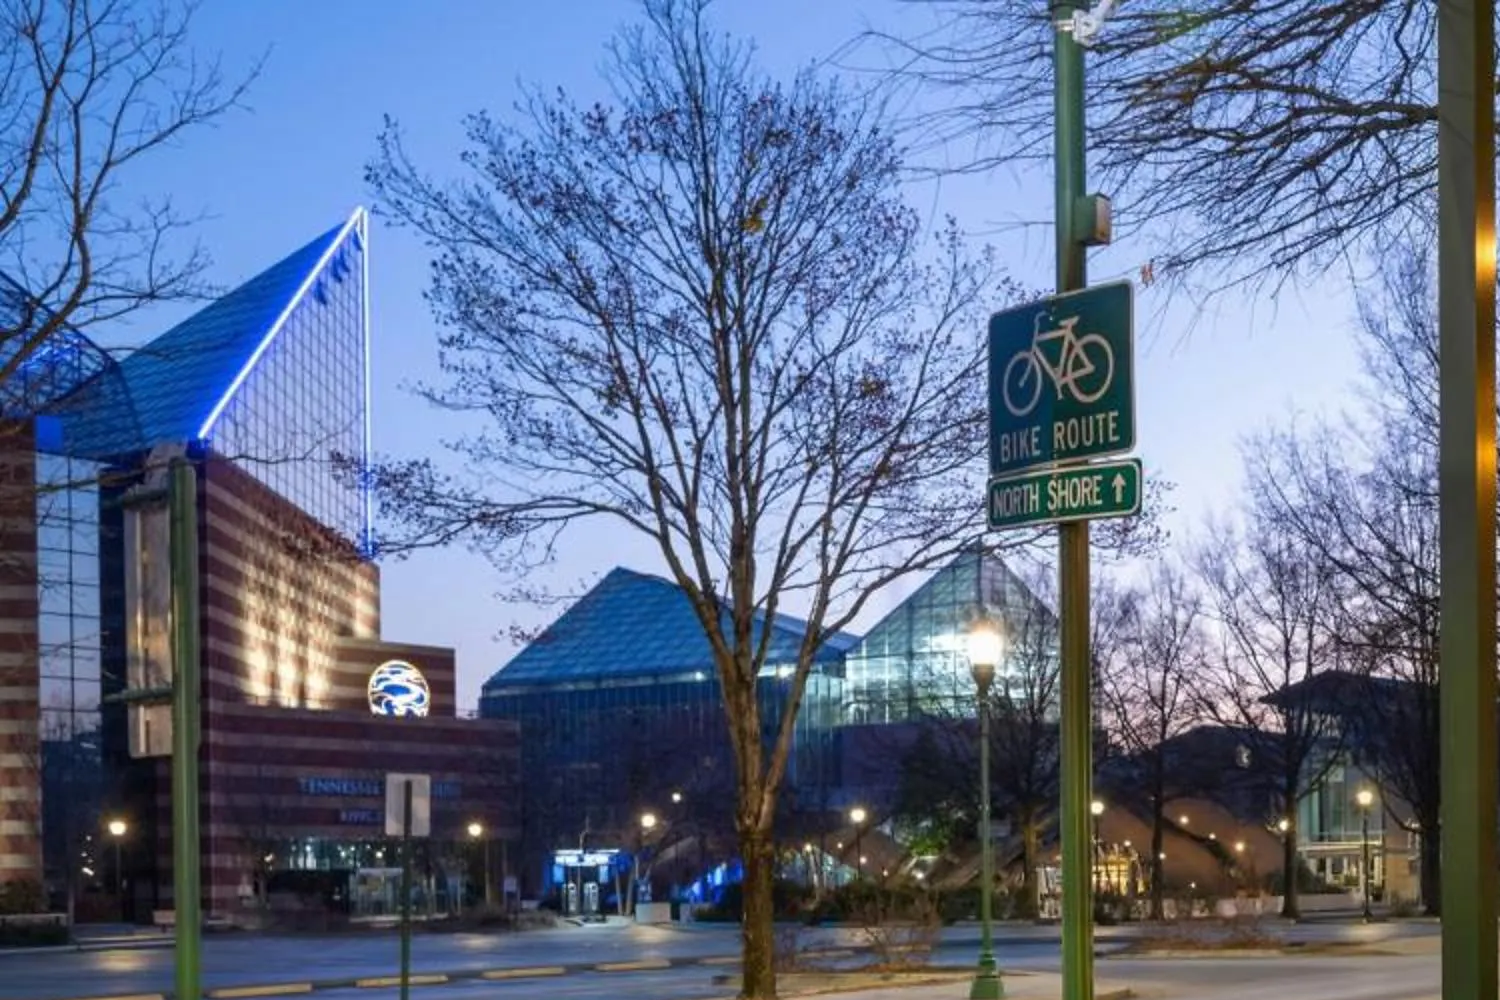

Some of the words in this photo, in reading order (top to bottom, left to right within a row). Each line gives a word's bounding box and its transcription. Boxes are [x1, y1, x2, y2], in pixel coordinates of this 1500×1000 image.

[1001, 426, 1041, 463] BIKE
[1053, 411, 1120, 450] ROUTE
[993, 482, 1039, 519] NORTH
[1047, 475, 1103, 511] SHORE
